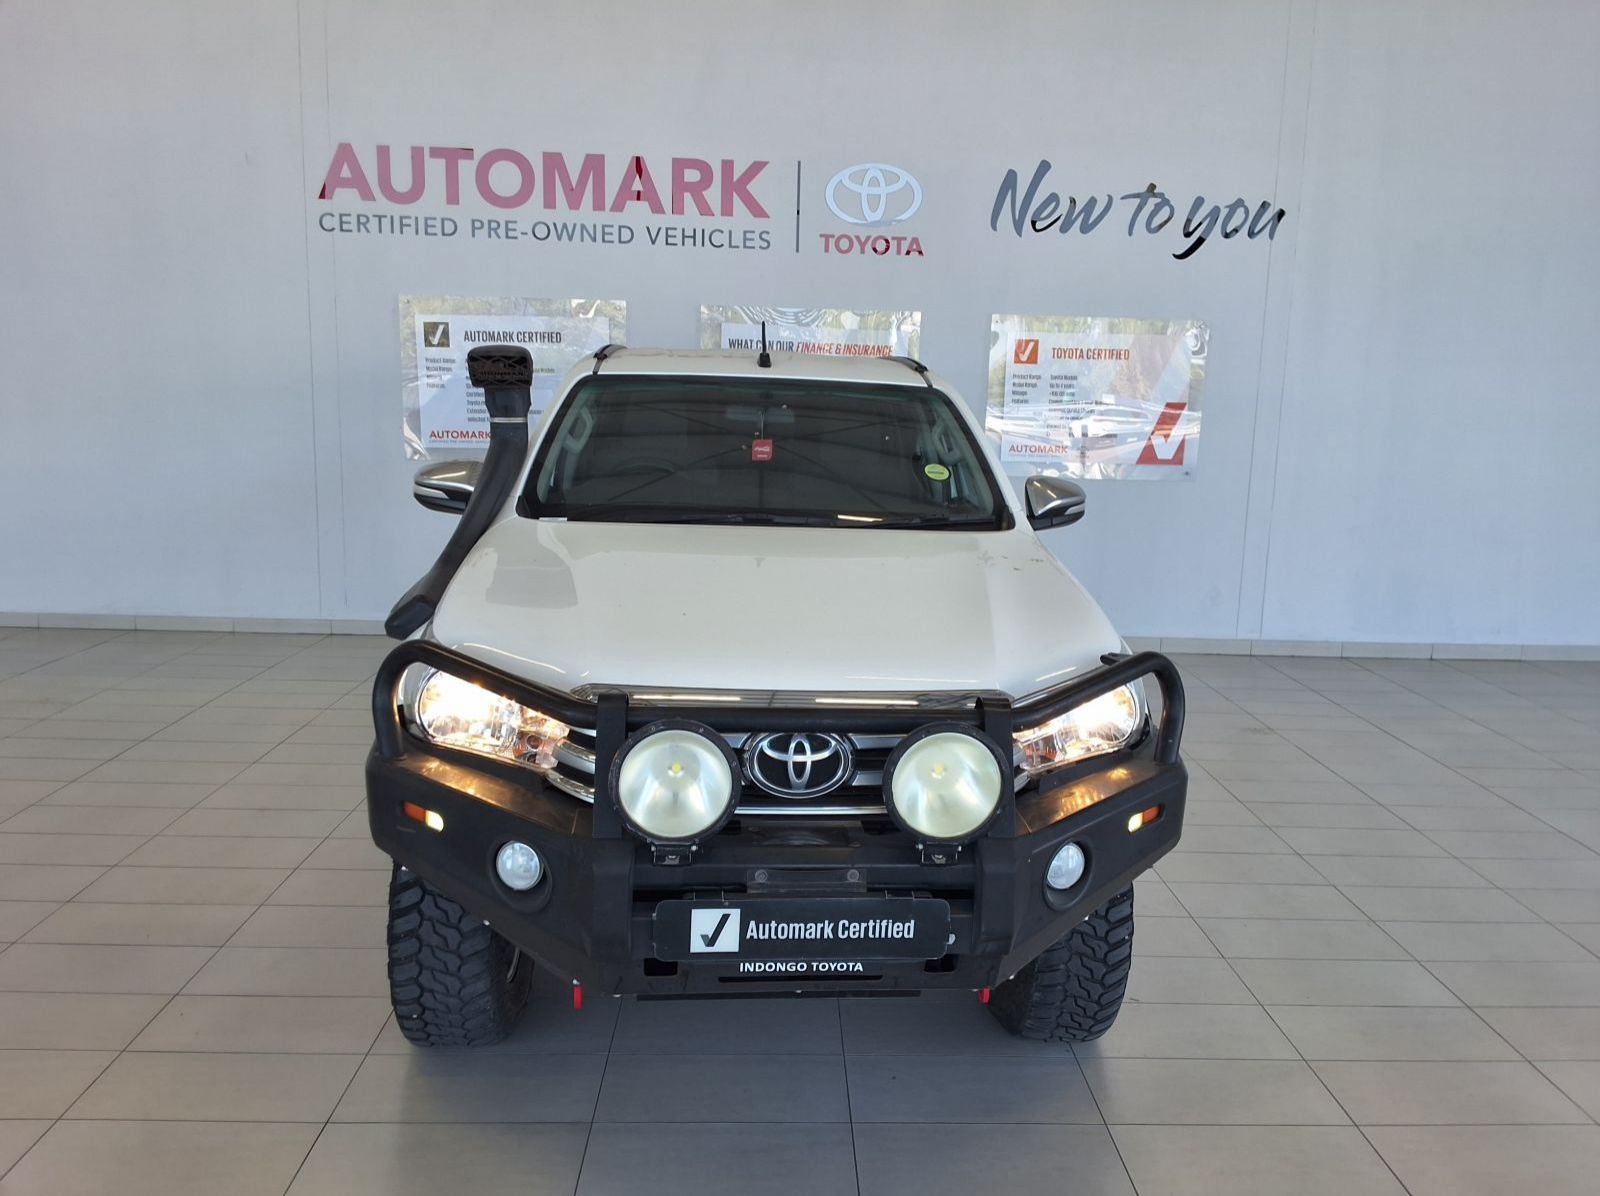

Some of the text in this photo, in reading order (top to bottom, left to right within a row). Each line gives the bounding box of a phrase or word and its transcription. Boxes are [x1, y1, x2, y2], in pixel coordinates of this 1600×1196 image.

[318, 142, 770, 219] AUTOMARK
[990, 158, 1286, 261] New to you
[318, 212, 771, 250] CERTIFIED PRE-OWNED VEHICLES
[819, 233, 924, 257] TOYOTA
[464, 330, 562, 344] AUTOMARK CERTIFIED
[728, 338, 892, 357] WHAT CN OUR FINANCE & INSURANCE
[1052, 347, 1130, 360] TOYOTA CERTIFIED
[430, 430, 491, 439] AUTOMARK
[1009, 444, 1068, 454] AUTOMARK
[746, 919, 915, 941] Automark Certified
[739, 961, 863, 973] INDONGO TOYOTA
